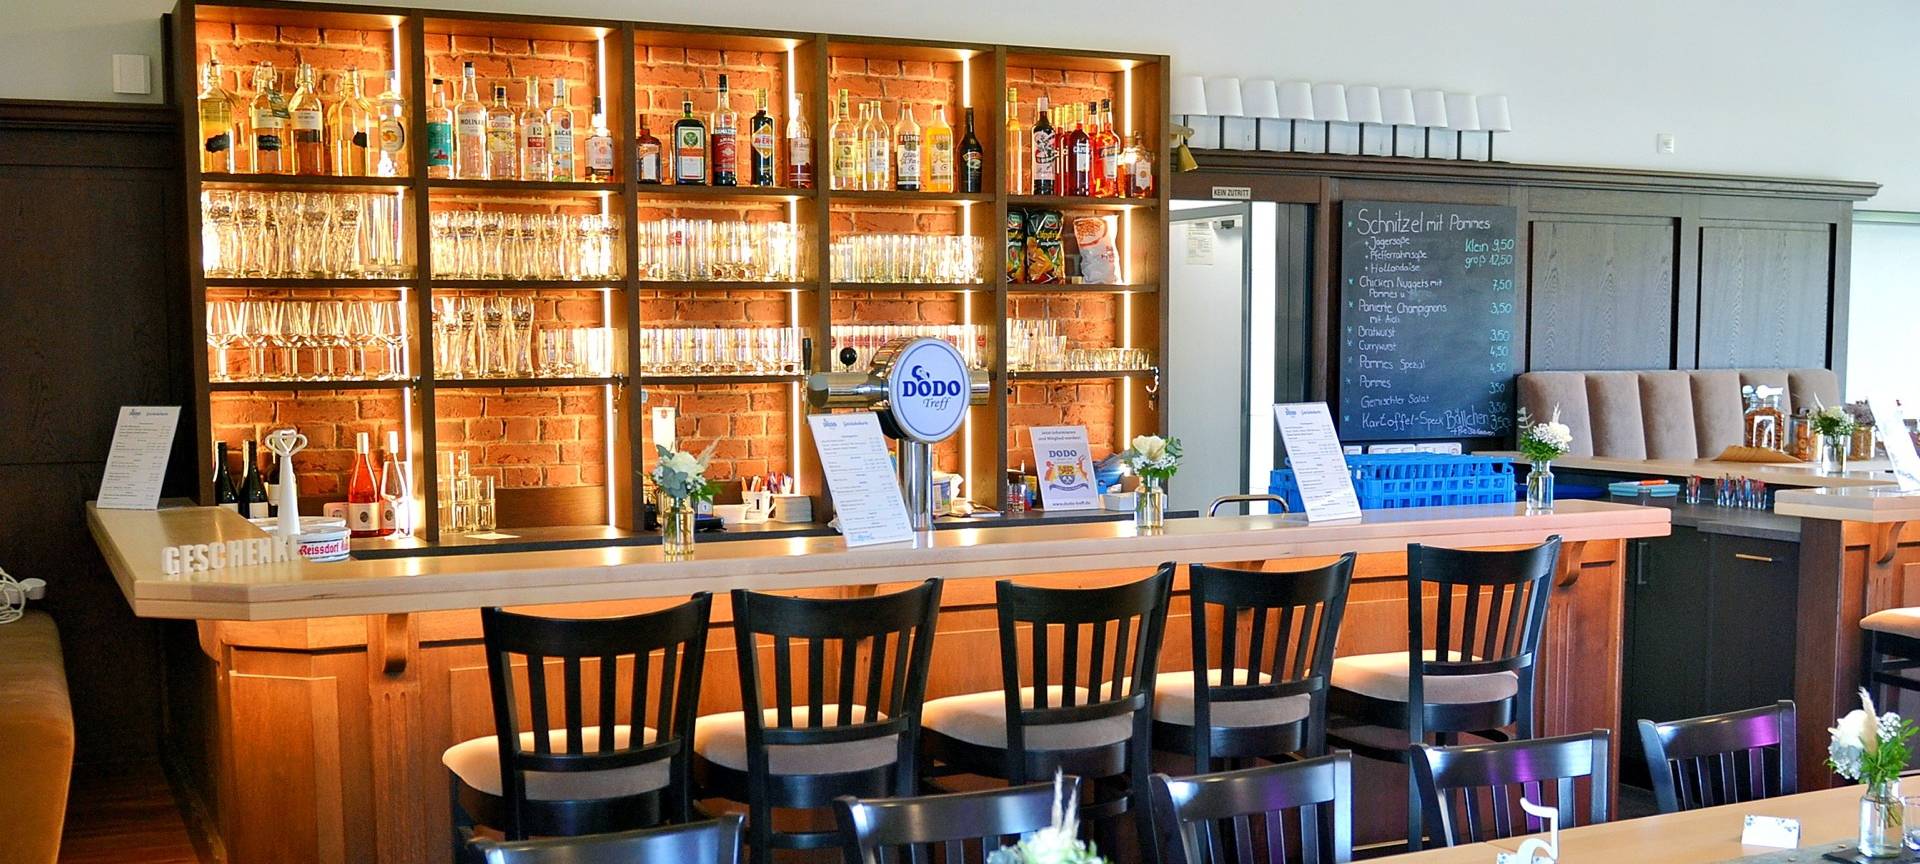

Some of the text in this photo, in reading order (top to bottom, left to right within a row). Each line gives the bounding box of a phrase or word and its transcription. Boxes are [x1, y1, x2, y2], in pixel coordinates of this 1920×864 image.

[1214, 188, 1249, 197] KEIN ZUTRITT
[1357, 208, 1491, 235] Schnitzel mit Pommes
[1491, 238, 1515, 253] 9,50
[1489, 254, 1513, 267] 12,50
[1359, 275, 1513, 292] Chicken Nuggets mit 7,50
[1368, 288, 1398, 299] Pommes
[1396, 302, 1448, 318] Champignons
[1490, 302, 1513, 316] 3,50
[1357, 325, 1397, 338] Bratwurst
[1358, 339, 1509, 358] Currywurst 4,50
[1359, 354, 1394, 370] Pommes
[1489, 363, 1506, 374] 4,50
[902, 380, 961, 397] DODO
[1359, 374, 1392, 389] Pommes
[922, 397, 952, 411] Treff
[1407, 393, 1430, 404] Salat
[1443, 404, 1489, 430] Bällchen
[1049, 449, 1078, 458] DODO
[298, 541, 340, 556] Reissdorf
